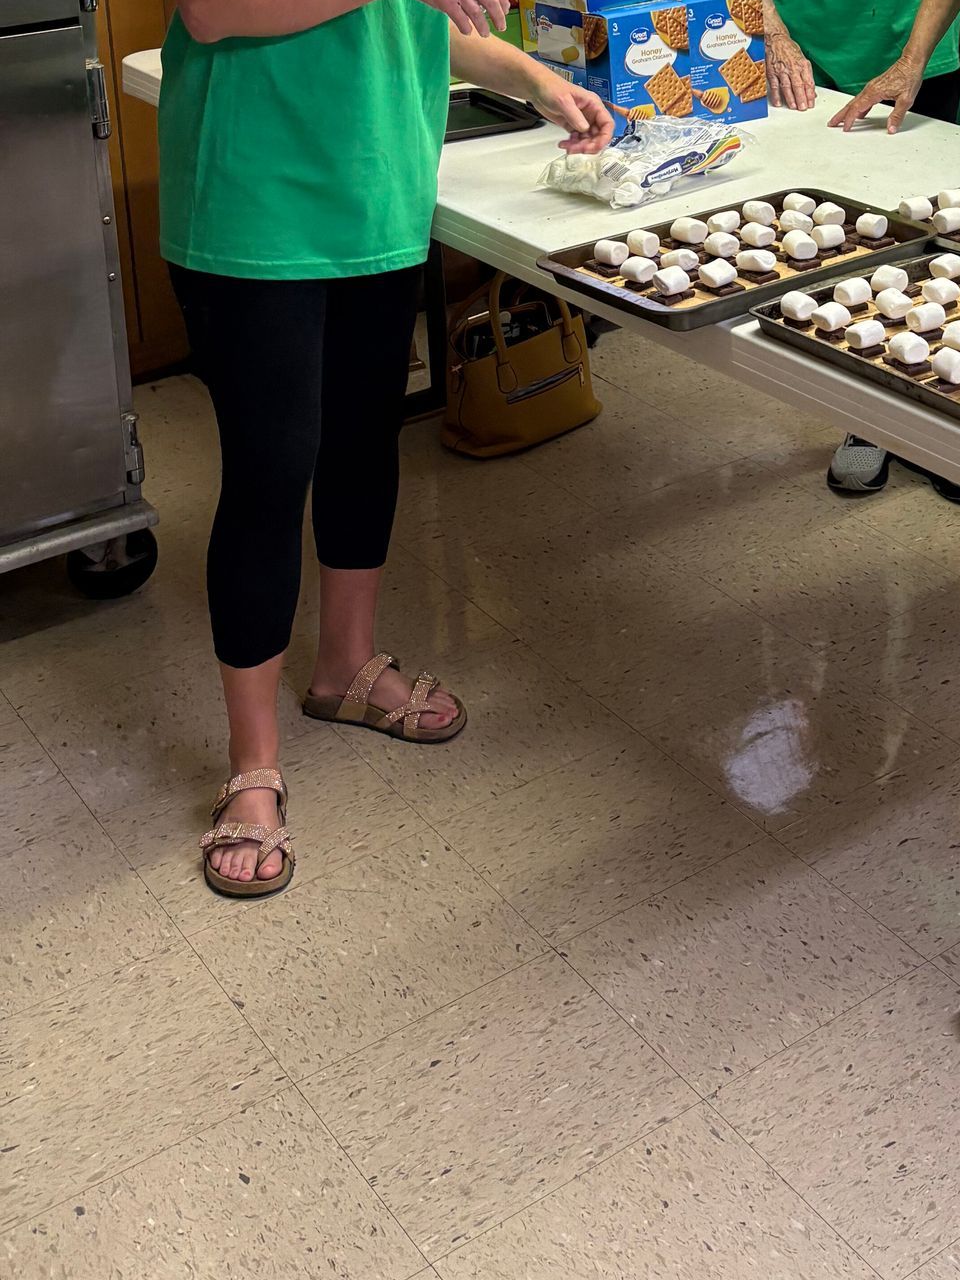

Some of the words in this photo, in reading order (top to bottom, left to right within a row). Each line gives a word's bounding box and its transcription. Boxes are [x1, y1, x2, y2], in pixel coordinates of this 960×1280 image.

[688, 8, 694, 17] 3
[612, 22, 618, 32] 3
[716, 33, 738, 41] Honey
[727, 38, 747, 46] Crackers
[641, 48, 662, 56] Honey
